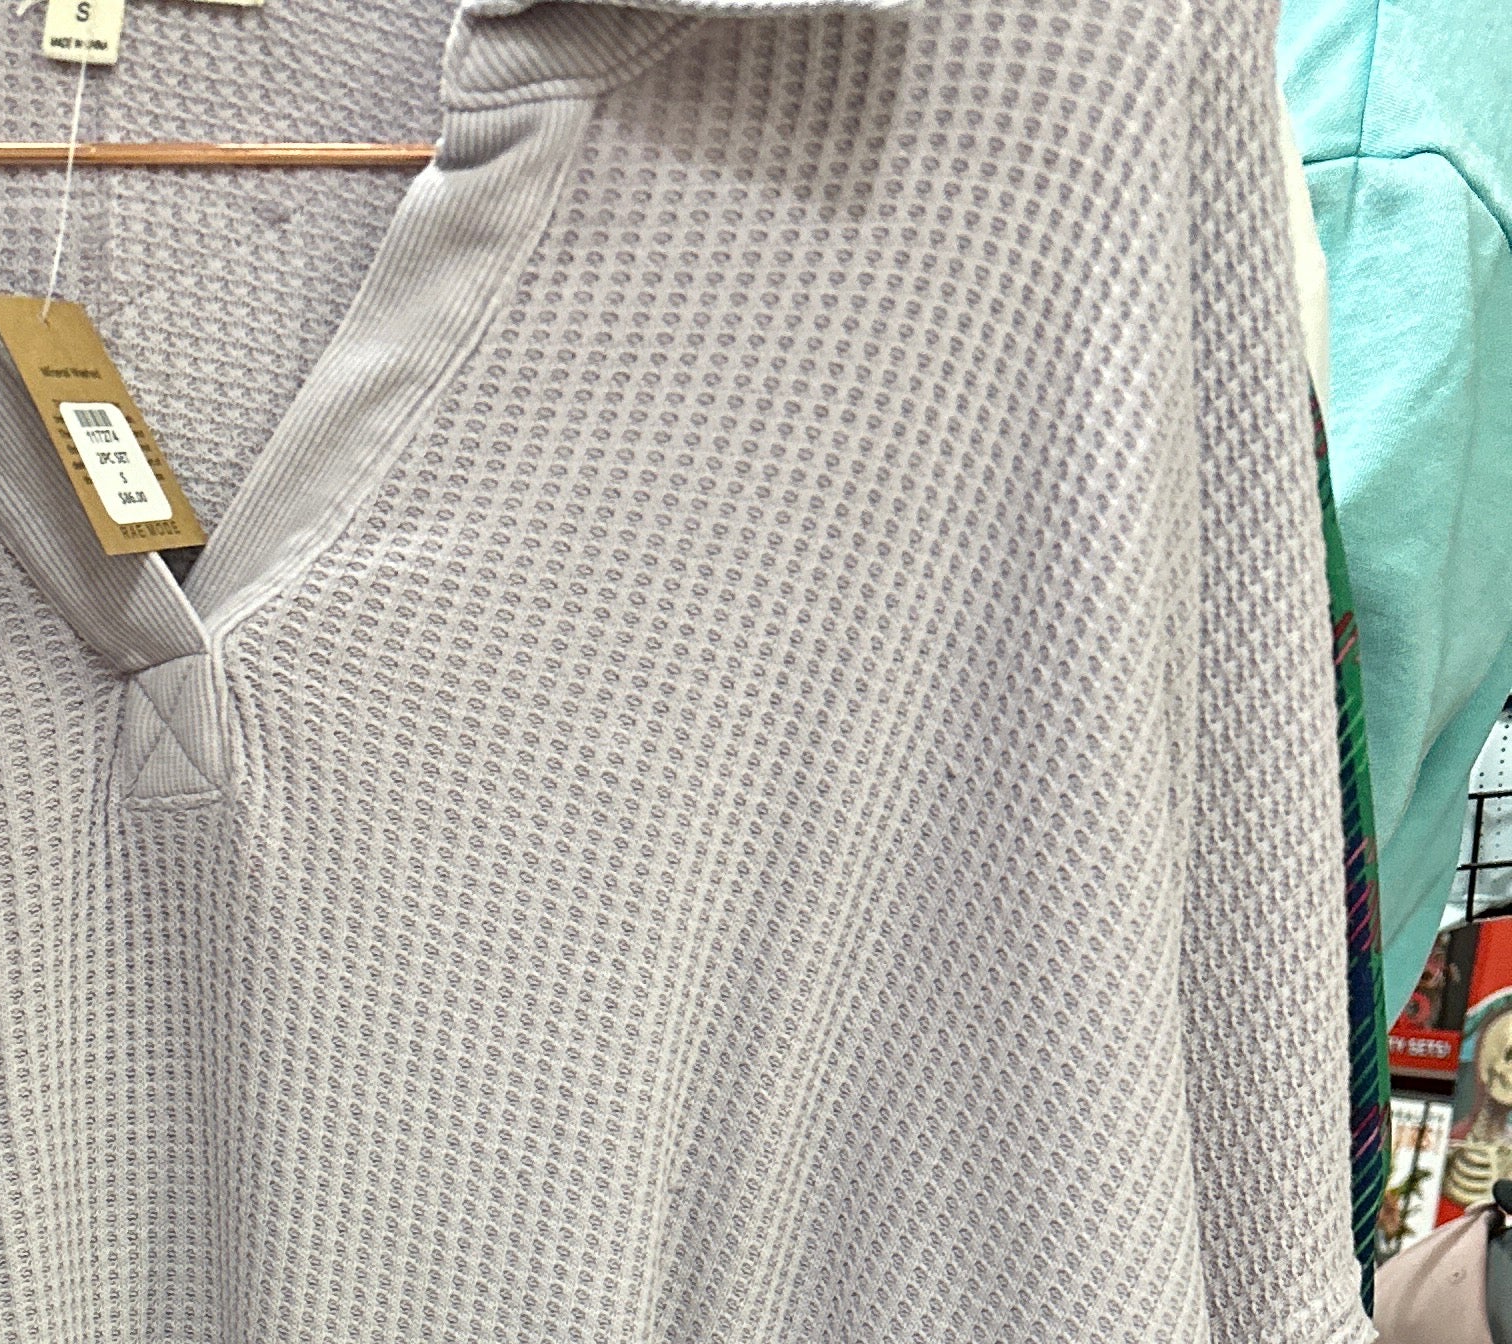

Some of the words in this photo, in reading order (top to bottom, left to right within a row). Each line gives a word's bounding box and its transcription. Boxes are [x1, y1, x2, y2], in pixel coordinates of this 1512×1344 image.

[76, 1, 91, 22] S
[113, 451, 130, 464] SET
[119, 524, 146, 539] RAE
[145, 521, 181, 536] MODE
